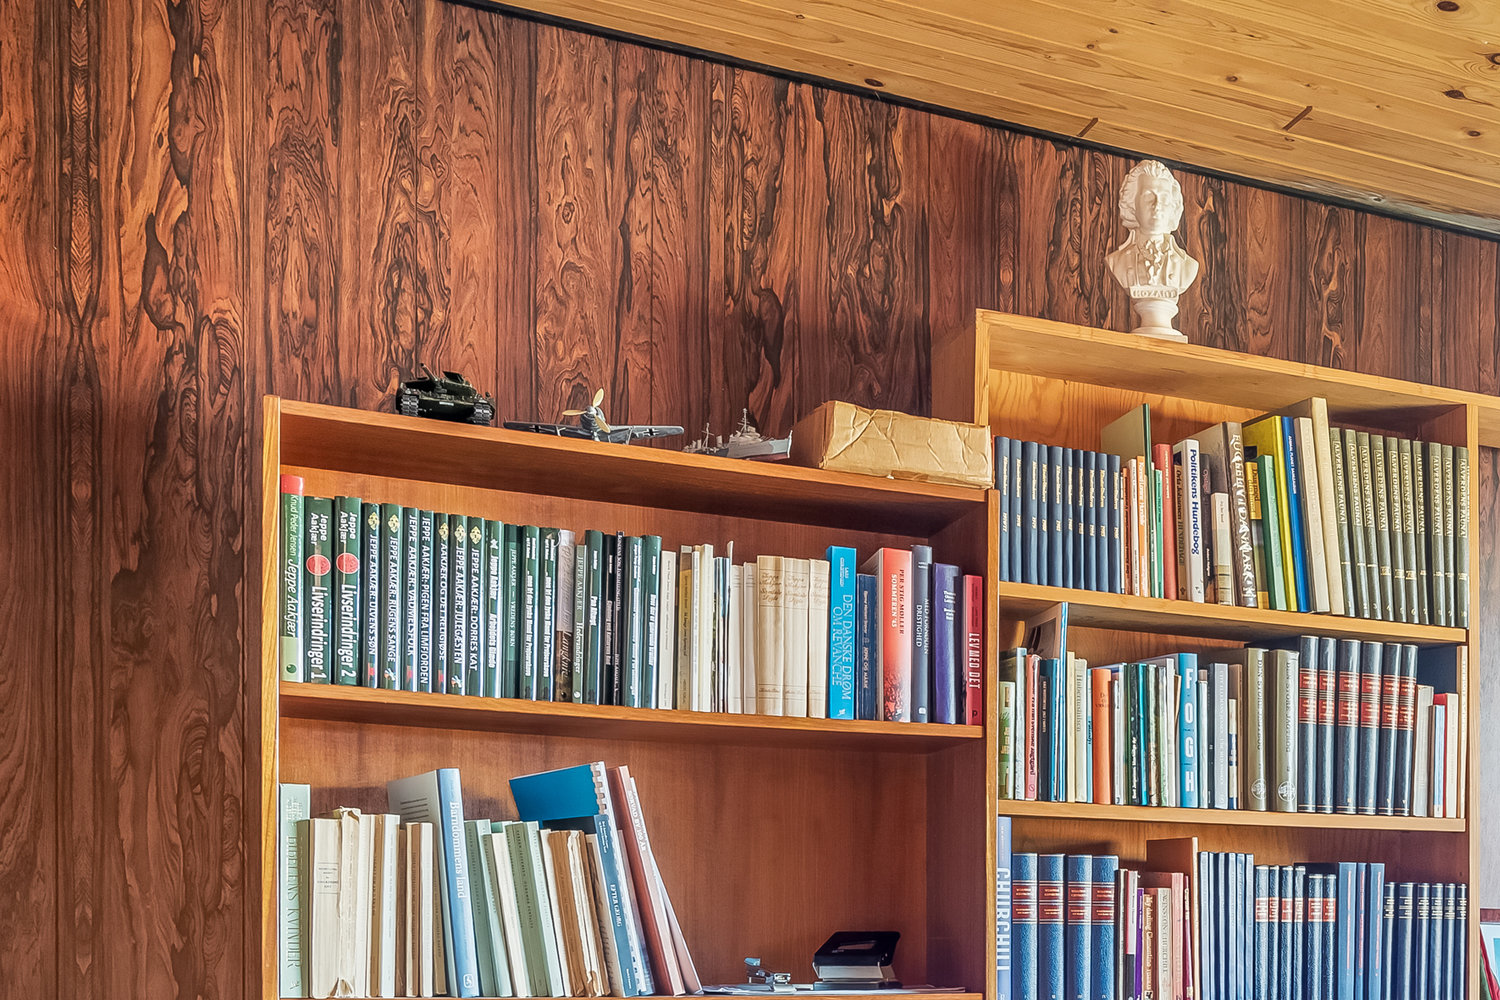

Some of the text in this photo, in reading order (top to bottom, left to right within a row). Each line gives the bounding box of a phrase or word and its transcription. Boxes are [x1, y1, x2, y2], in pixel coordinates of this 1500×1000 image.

[1334, 443, 1342, 491] ALVERDENS
[1350, 446, 1358, 493] ALVERDENS
[1362, 448, 1370, 495] ALVERDENS
[1376, 451, 1386, 528] ALVERDENS FAUNA
[1402, 455, 1410, 501] ALVERDENS
[288, 495, 299, 556] Knud Peder Jensen
[348, 512, 357, 539] Jeppe
[1190, 449, 1199, 555] Politikens Hundebog
[1460, 509, 1468, 535] FAUNA
[309, 513, 319, 546] Aakjær
[318, 514, 328, 541] Jeppe
[339, 511, 347, 544] Aakjær
[409, 515, 417, 542] JEPPE
[422, 517, 430, 541] JEPPE
[369, 561, 377, 600] AAKJÆR:
[422, 545, 430, 582] AAKJÆR:
[440, 543, 448, 596] AAKJÆR OG
[285, 559, 299, 638] Jeppe Aakjær
[387, 536, 398, 662] JEPPE AAKJÆR: RUGENS SANGE
[421, 584, 429, 610] PIGEN
[455, 572, 463, 609] AAKJÆR:
[469, 548, 479, 670] JEPPE AAKJÆR: DORRES KAT
[307, 586, 328, 670] Livserindringer
[338, 584, 356, 668] Livserindringer
[368, 601, 376, 634] ULVENS
[454, 610, 463, 663] JULEGÆSTEN
[420, 631, 428, 683] LIMFJORDEN
[574, 622, 583, 673] Hedevandringer
[832, 607, 842, 686] OM REVANCHE
[842, 594, 853, 700] DEN DANSKE DRØM
[969, 633, 980, 689] LEV MED DET
[1185, 668, 1194, 792] FOGH
[449, 801, 466, 898] Barndommens land
[610, 884, 623, 927] EFTER GEORG
[1146, 897, 1152, 907] My
[287, 908, 301, 968] KVINDER
